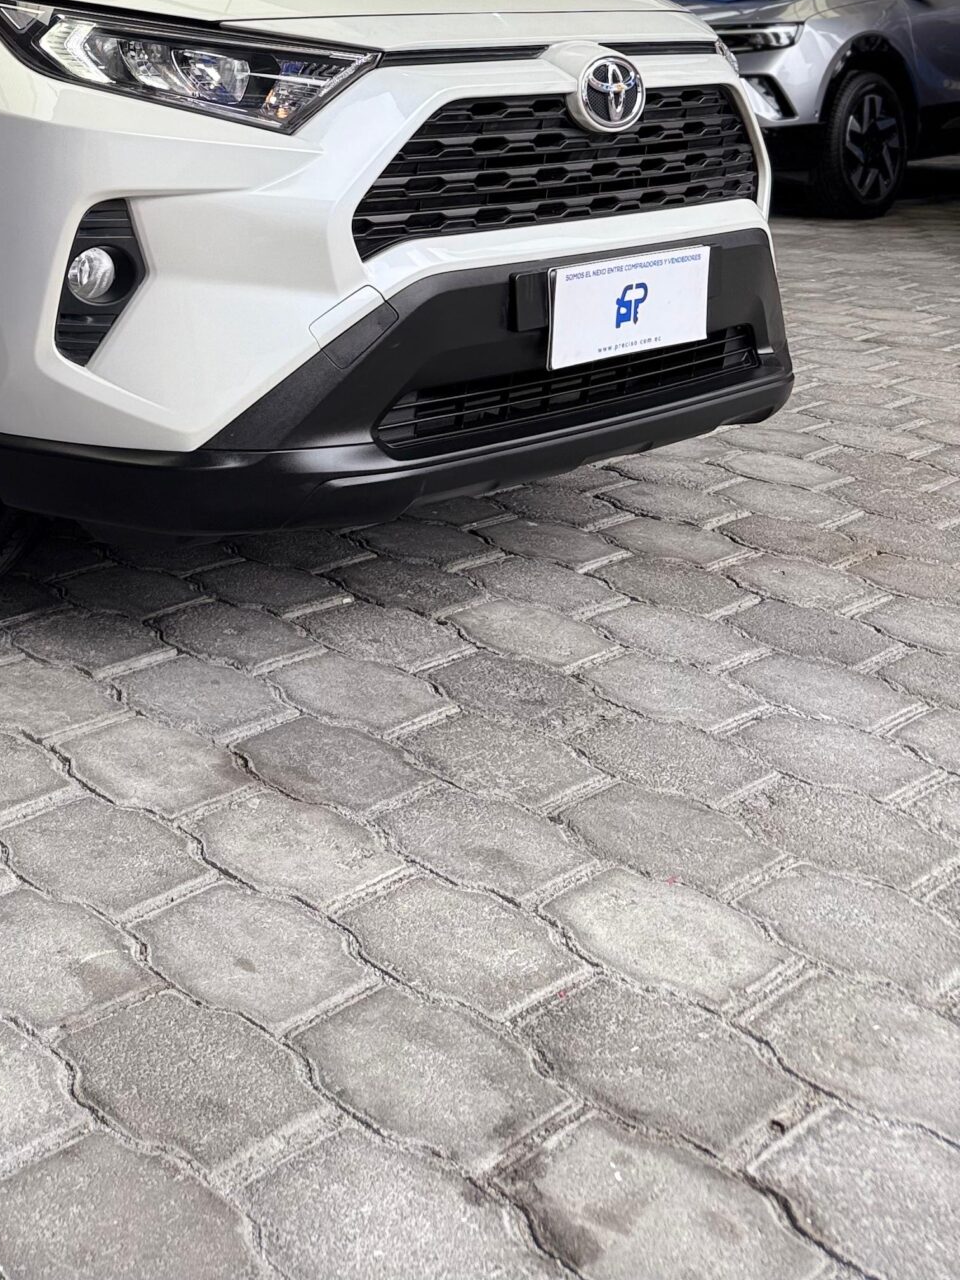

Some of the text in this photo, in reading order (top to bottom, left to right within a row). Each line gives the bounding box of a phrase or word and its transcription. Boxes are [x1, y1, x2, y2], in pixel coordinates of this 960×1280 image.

[565, 272, 585, 281] SOMOS
[592, 269, 607, 277] NEXO
[607, 266, 623, 274] ENTRE
[624, 260, 663, 272] COMPRADORES
[668, 253, 701, 265] VENDEDORES
